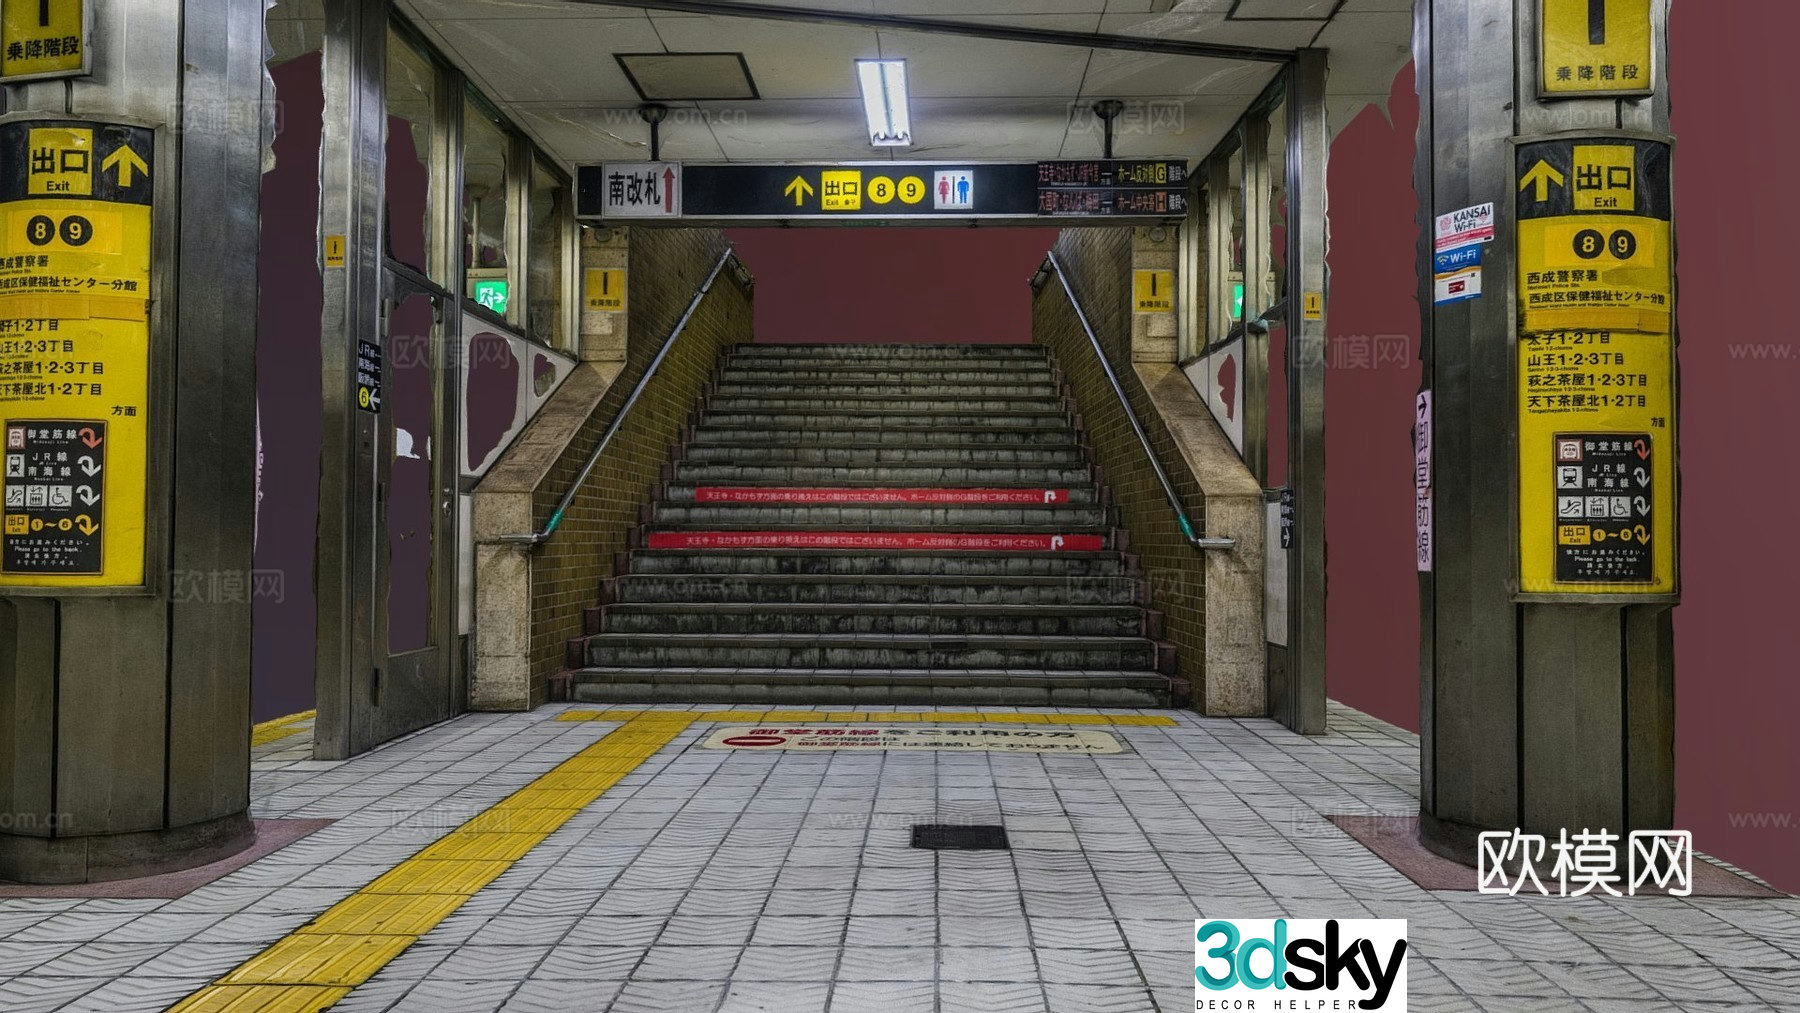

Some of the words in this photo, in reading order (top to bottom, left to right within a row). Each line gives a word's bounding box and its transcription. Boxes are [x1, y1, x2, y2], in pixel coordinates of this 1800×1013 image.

[7, 36, 79, 60] 乗降階段
[1556, 65, 1638, 81] 乗降階段
[32, 147, 89, 175] 出口
[1576, 164, 1632, 191] 出口
[46, 180, 70, 192] Exit
[608, 171, 660, 206] 南改札
[825, 181, 858, 196] 出口
[1594, 197, 1617, 208] Exit
[1453, 205, 1490, 224] KANSAI
[1454, 219, 1476, 232] Wi-Fi
[1450, 249, 1476, 263] Wi-Fi
[1527, 269, 1598, 284] 西成警察署
[1529, 290, 1666, 305] 西成区保健福祉センター分館
[111, 405, 137, 417] 方面
[1651, 417, 1666, 427] 方面
[28, 429, 77, 439] 御堂筋線
[1585, 441, 1633, 452] 御堂筋線
[32, 452, 68, 462] JR線
[28, 466, 71, 476] 南海線
[1591, 463, 1626, 473] JR線
[1587, 478, 1629, 488] 南海線
[1563, 527, 1585, 537] 出口
[748, 728, 1076, 738] 御堂筋線をご利用の方
